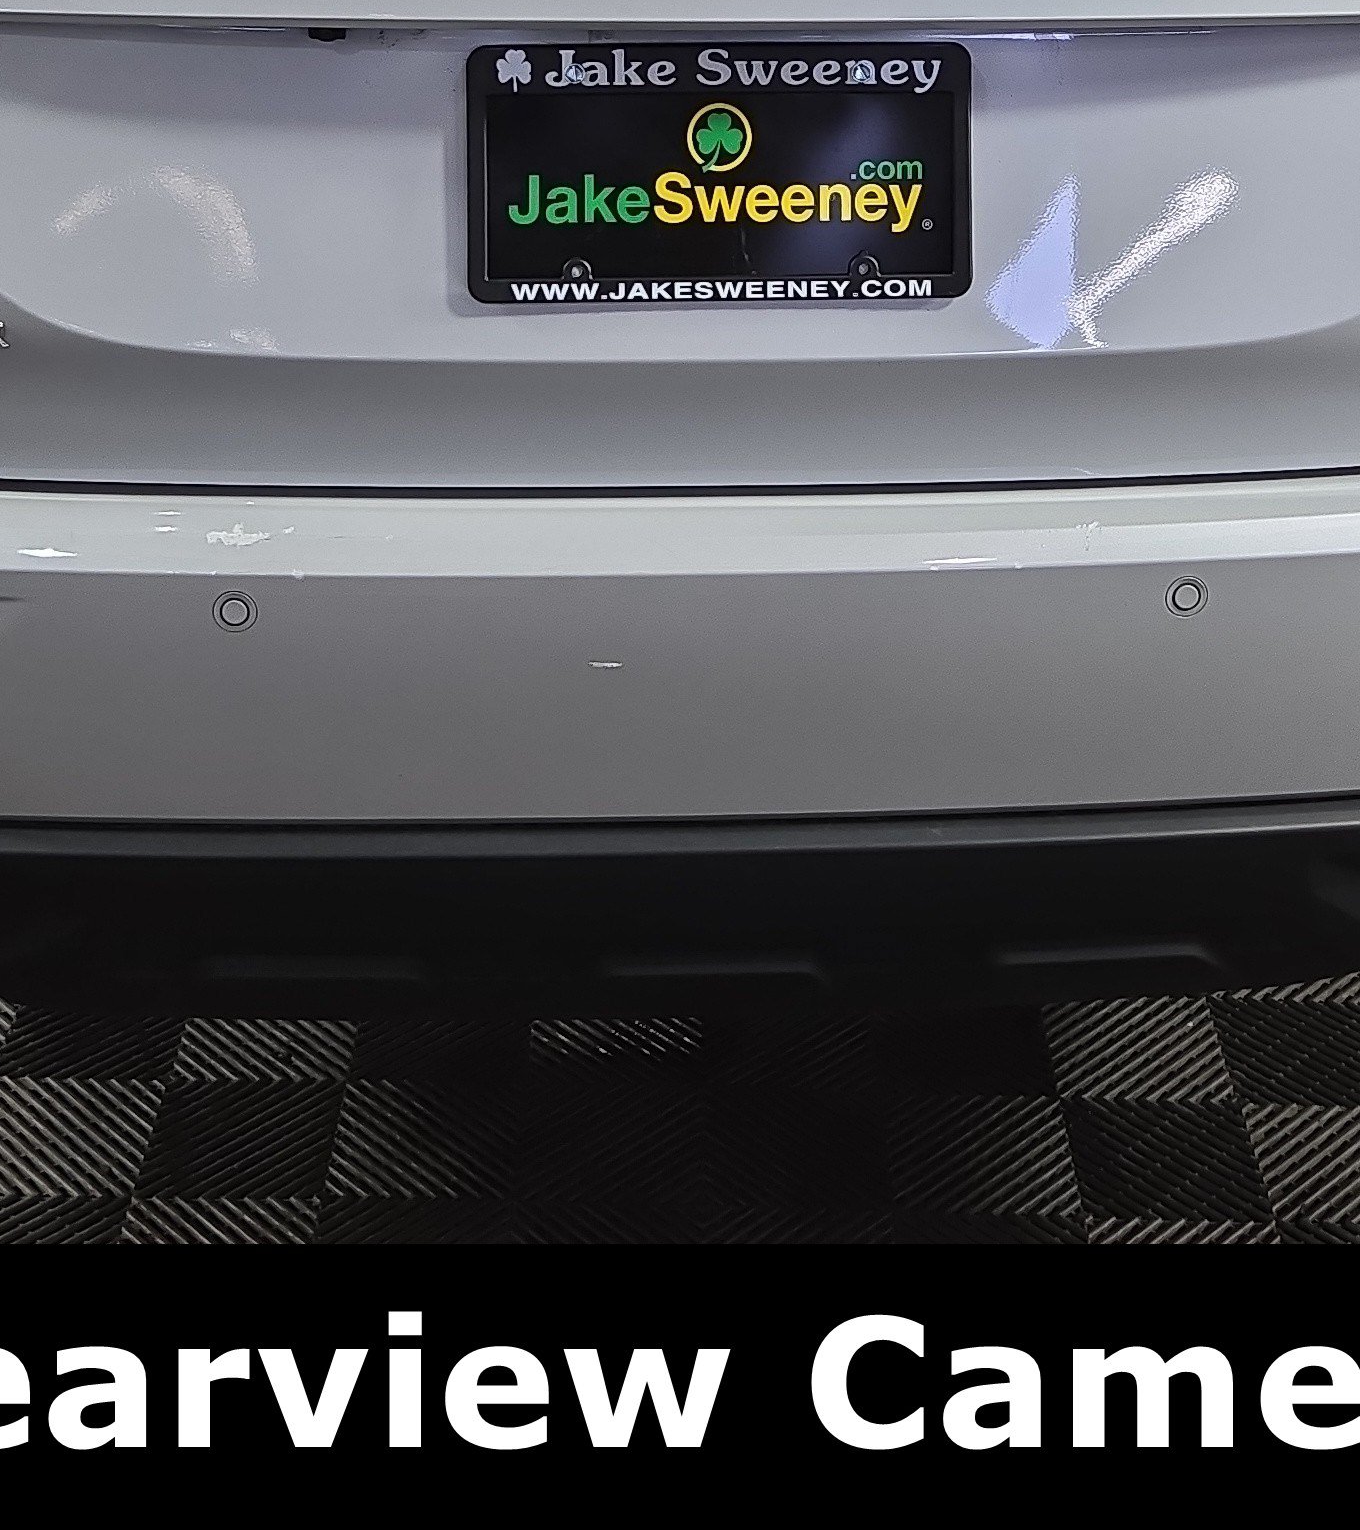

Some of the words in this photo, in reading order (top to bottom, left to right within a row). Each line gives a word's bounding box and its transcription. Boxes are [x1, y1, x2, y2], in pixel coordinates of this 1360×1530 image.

[545, 50, 676, 87] Jake
[696, 49, 941, 93] Sweeney
[850, 160, 923, 180] .com
[511, 280, 933, 301] WWW.JAKESWEENEY.COM
